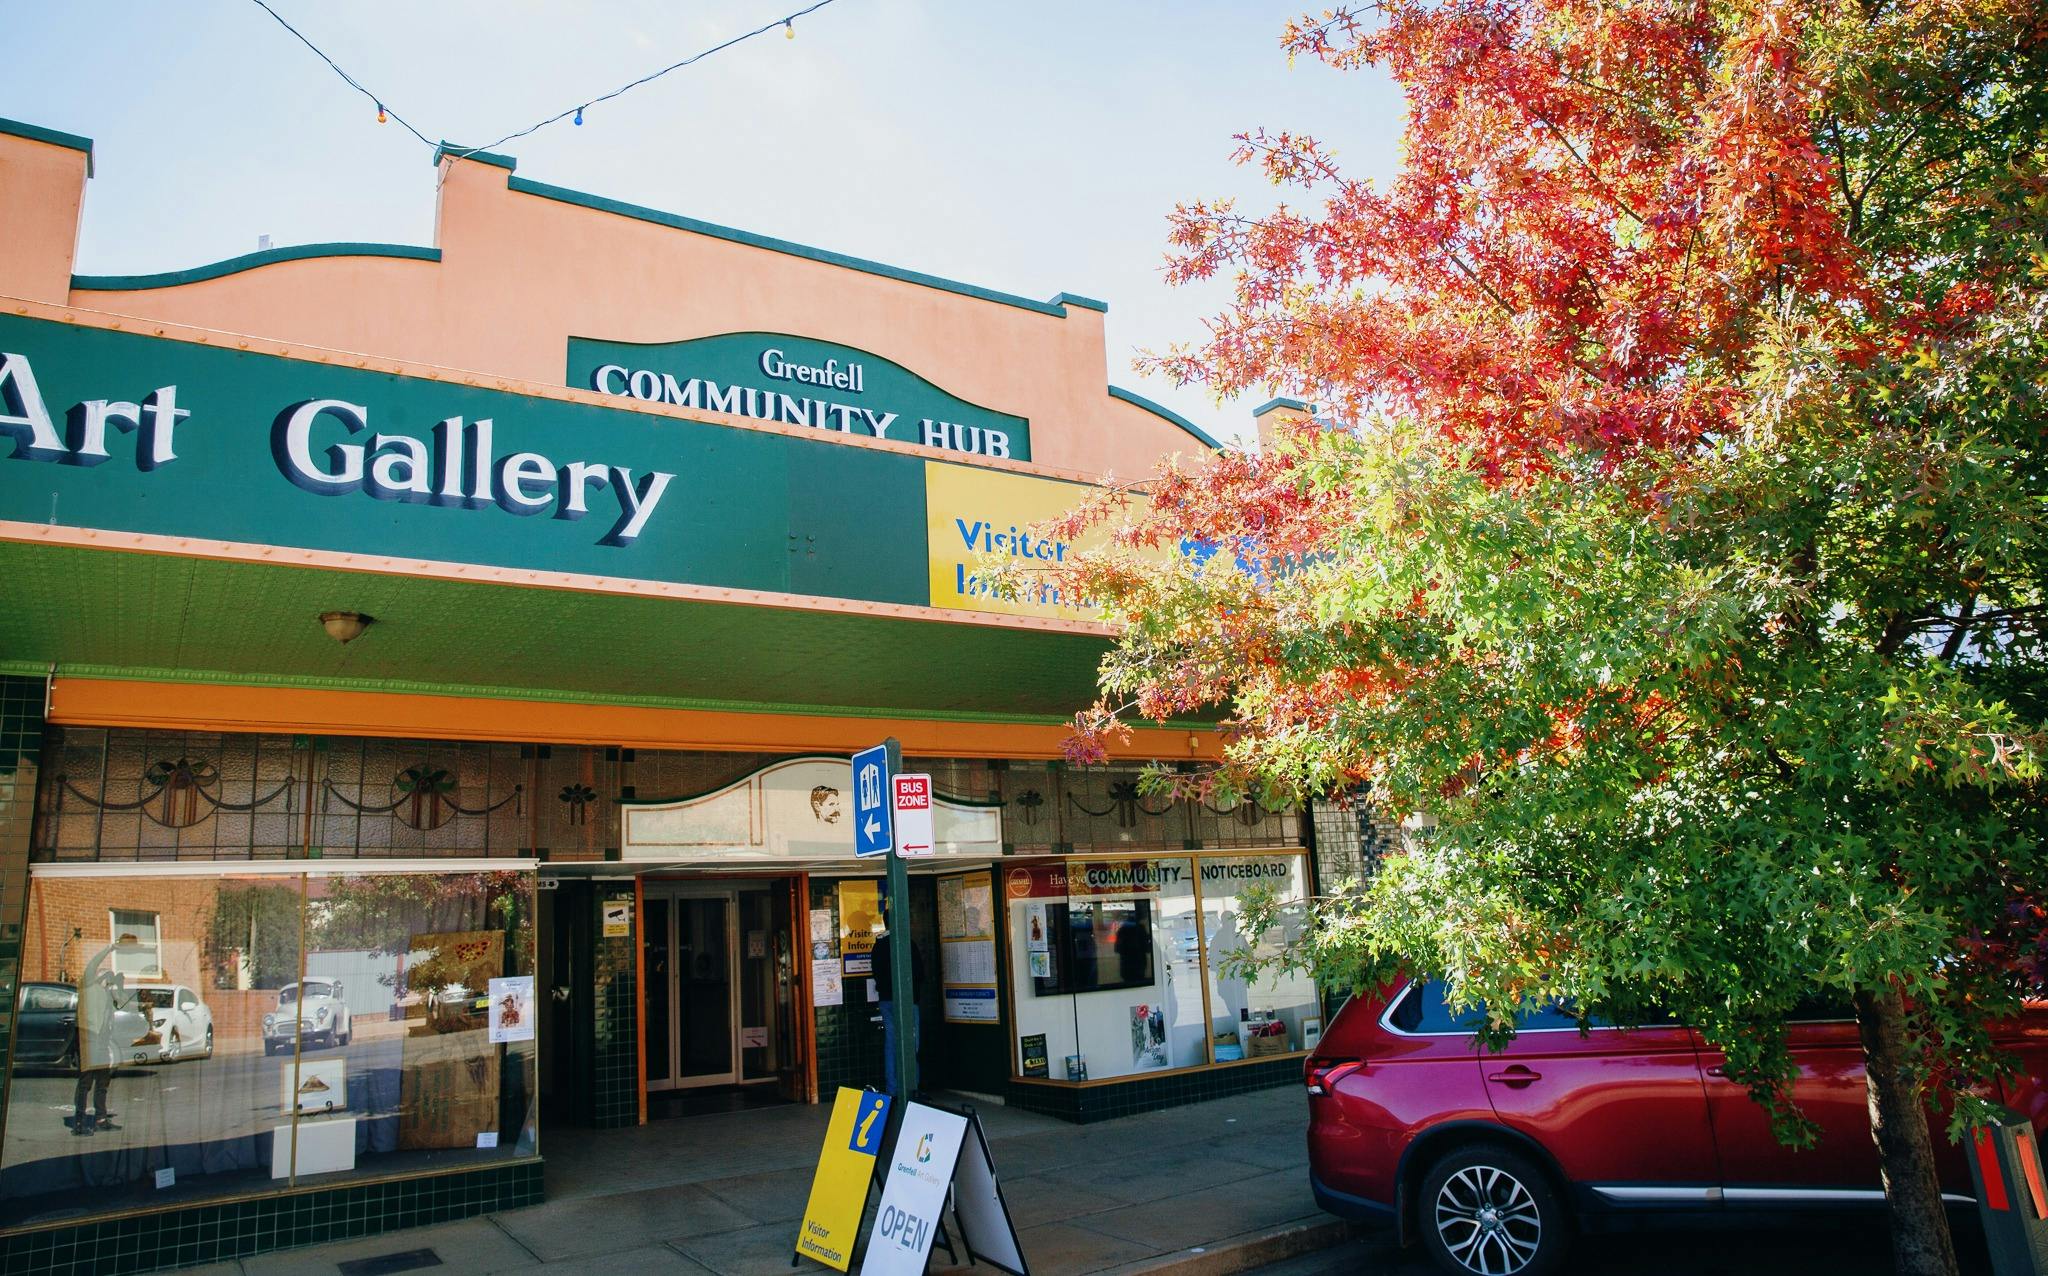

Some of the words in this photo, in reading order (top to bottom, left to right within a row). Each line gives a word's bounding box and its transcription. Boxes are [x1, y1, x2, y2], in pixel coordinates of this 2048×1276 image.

[759, 348, 864, 393] Grenfell
[593, 364, 899, 439] COMMUNITY
[919, 418, 1011, 459] HUB
[0, 352, 191, 469] Art
[272, 398, 677, 545] Gallery
[956, 518, 1070, 562] Visitor
[900, 782, 924, 793] BUS
[898, 795, 928, 806] ZONE
[1087, 866, 1182, 885] COMMUNITY
[1200, 862, 1287, 880] NOTICEBOARD
[848, 929, 873, 938] Visito
[897, 1162, 918, 1177] Grenfell
[807, 1219, 830, 1239] Visitor
[881, 1205, 929, 1253] OPEN
[801, 1236, 842, 1262] Information
